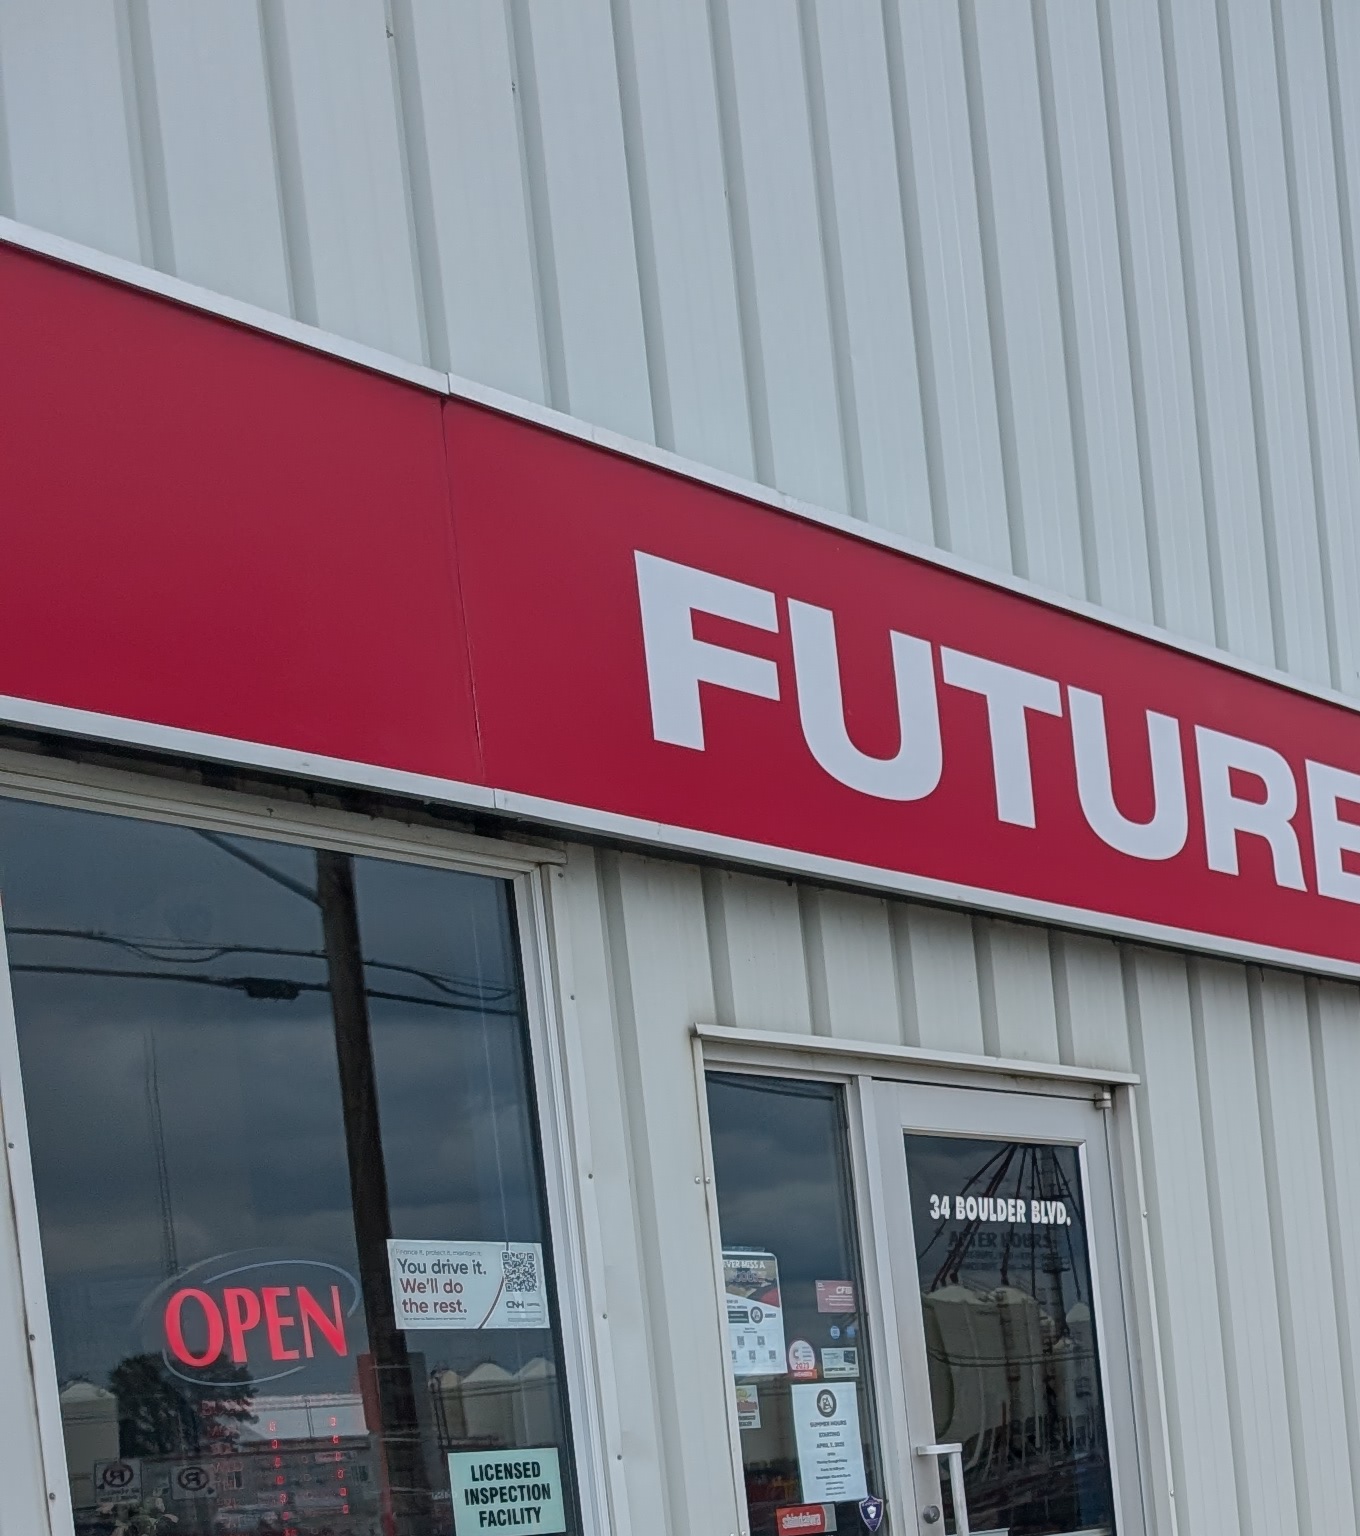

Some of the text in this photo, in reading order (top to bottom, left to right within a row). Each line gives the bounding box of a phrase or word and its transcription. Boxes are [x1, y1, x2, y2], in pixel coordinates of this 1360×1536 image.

[929, 1193, 1072, 1227] 34 BOULDER BLVD.
[397, 1258, 487, 1275] You drive it.
[399, 1277, 464, 1294] We'll do
[402, 1298, 468, 1314] the rest.
[165, 1284, 349, 1368] OPEN
[470, 1461, 541, 1482] LICENSED
[464, 1482, 551, 1506] INSPECTION
[479, 1506, 541, 1528] FACILITY
